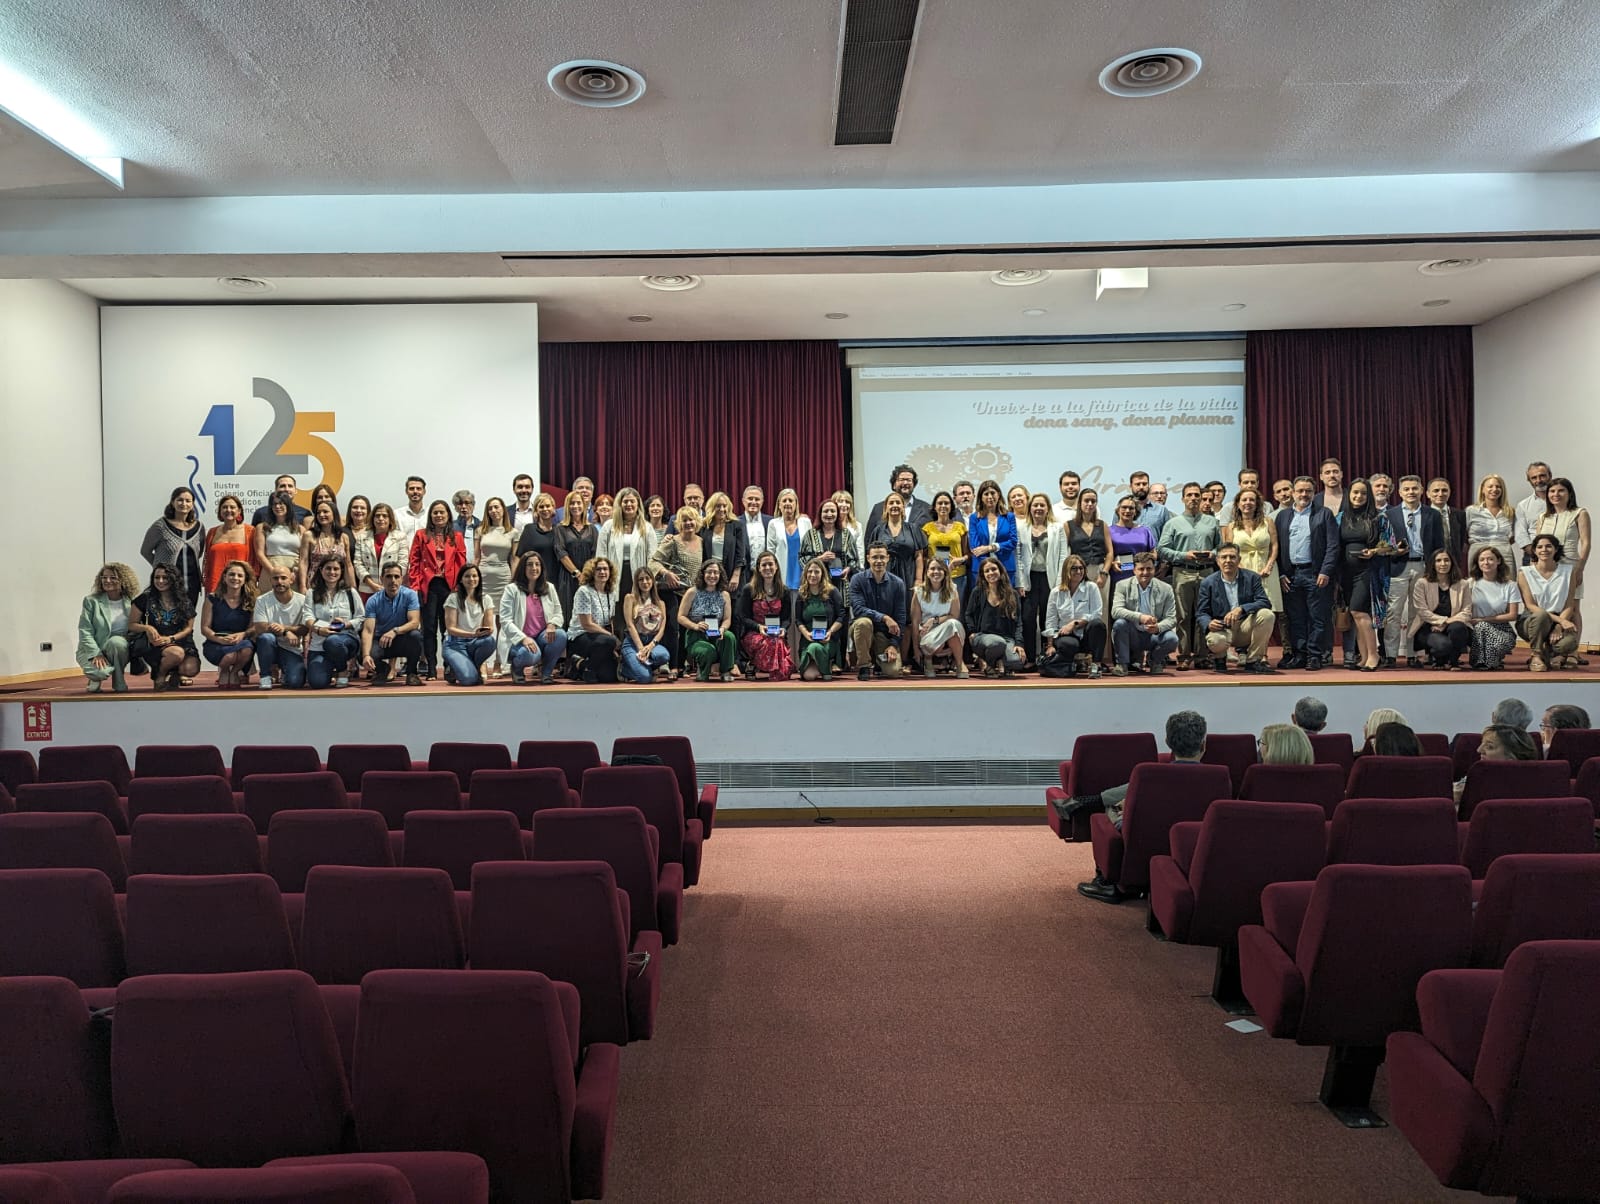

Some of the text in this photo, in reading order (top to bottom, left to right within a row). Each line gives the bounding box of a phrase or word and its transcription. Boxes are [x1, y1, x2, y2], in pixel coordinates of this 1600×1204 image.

[972, 400, 1046, 415] Uneix-te
[1050, 403, 1063, 414] a
[1066, 401, 1085, 414] la
[1154, 398, 1174, 411] de
[1177, 397, 1195, 411] la
[1200, 397, 1239, 411] vida
[1023, 412, 1236, 431] dona sang, dona plasma
